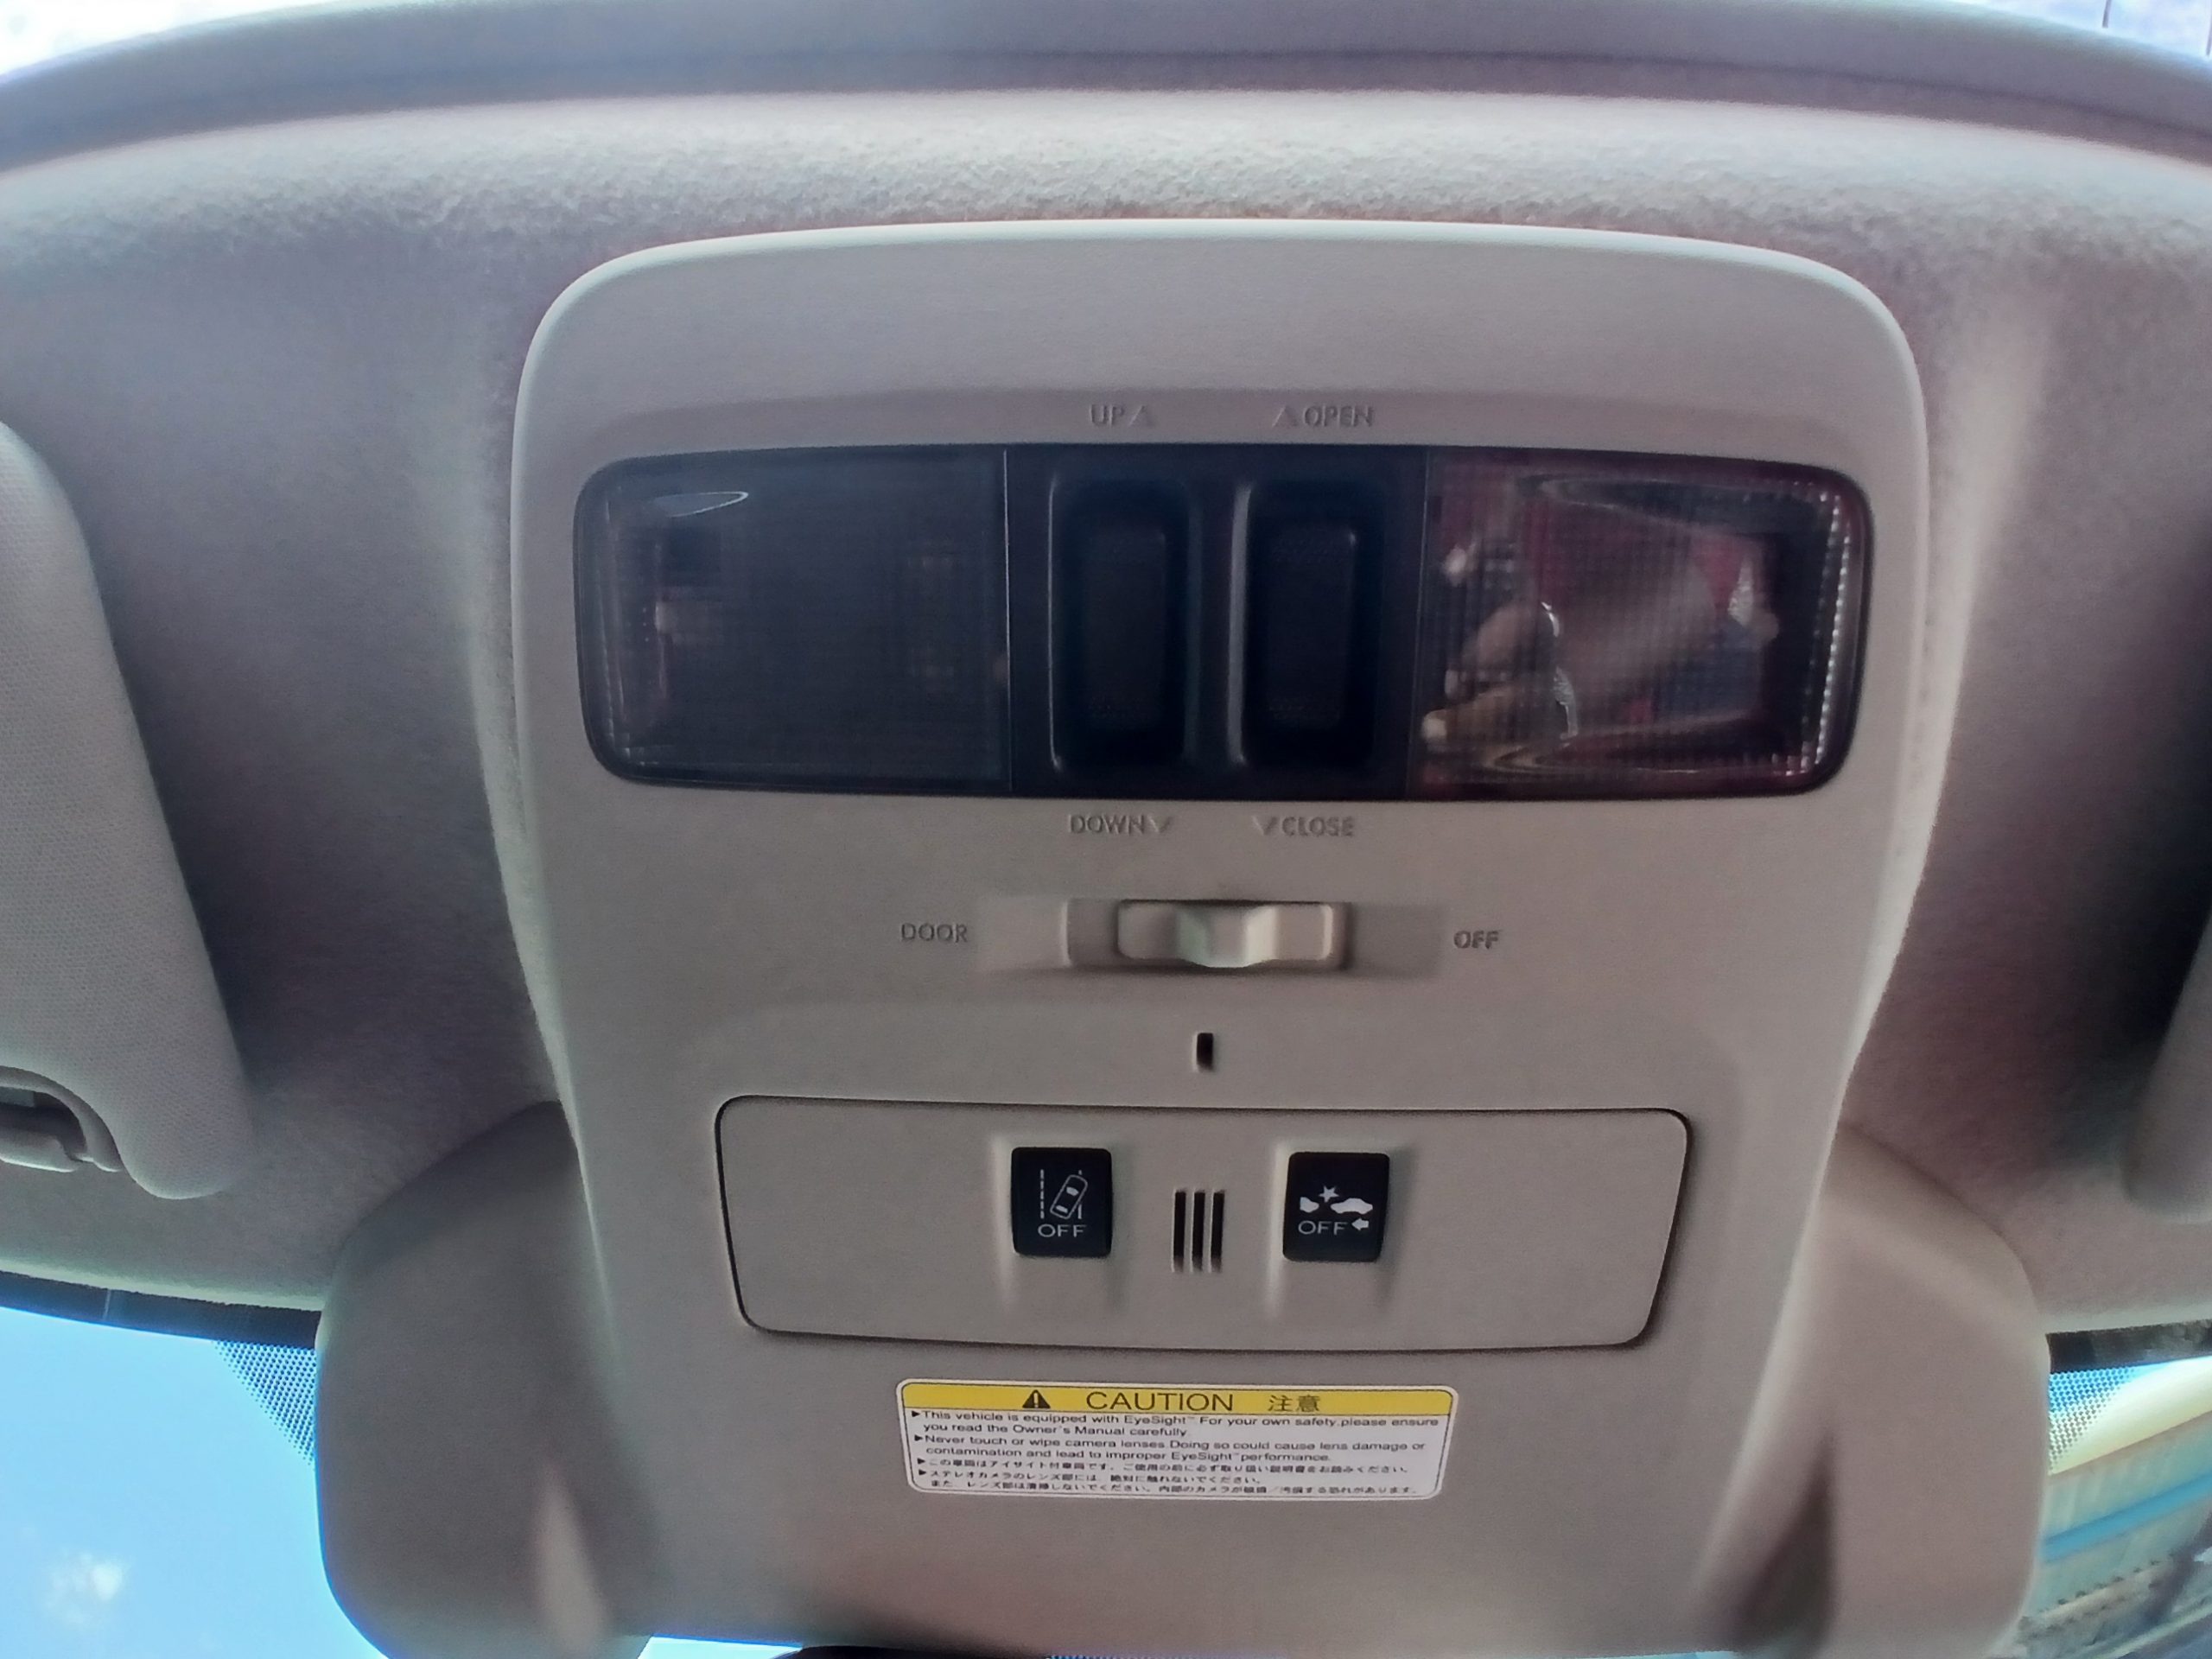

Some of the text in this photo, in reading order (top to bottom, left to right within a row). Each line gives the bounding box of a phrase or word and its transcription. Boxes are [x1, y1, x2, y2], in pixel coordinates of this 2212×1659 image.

[1089, 404, 1124, 427] UP
[1303, 404, 1376, 428] OPEN
[1068, 814, 1146, 835] DOWN
[1281, 816, 1356, 837] CLOSE
[901, 922, 969, 944] DOOR
[1453, 930, 1500, 950] OFF
[1037, 1223, 1088, 1238] OFF
[1296, 1219, 1348, 1236] OFF
[1086, 1390, 1234, 1412] CAUTION
[1267, 1394, 1321, 1413] 注意
[921, 1410, 951, 1420] This
[956, 1411, 1003, 1421] vehicle
[1007, 1412, 1019, 1421] is
[1023, 1414, 1087, 1424] equipped
[1091, 1414, 1119, 1424] with
[1199, 1416, 1223, 1426] For
[1227, 1418, 1257, 1427] your
[1341, 1418, 1386, 1427] please
[923, 1423, 948, 1433] you
[952, 1424, 982, 1433] read
[987, 1424, 1008, 1433] the
[1075, 1426, 1125, 1435] Manual
[925, 1434, 965, 1444] Never
[969, 1436, 1007, 1446] touch
[1029, 1438, 1060, 1448] wipe
[1170, 1440, 1210, 1451] Doing
[1233, 1441, 1270, 1451] could
[1319, 1442, 1348, 1451] lens
[1351, 1442, 1408, 1452] damage
[926, 1447, 1022, 1458] contamination
[1026, 1449, 1052, 1458] and
[1056, 1450, 1084, 1459] lead
[1106, 1452, 1166, 1461] improper
